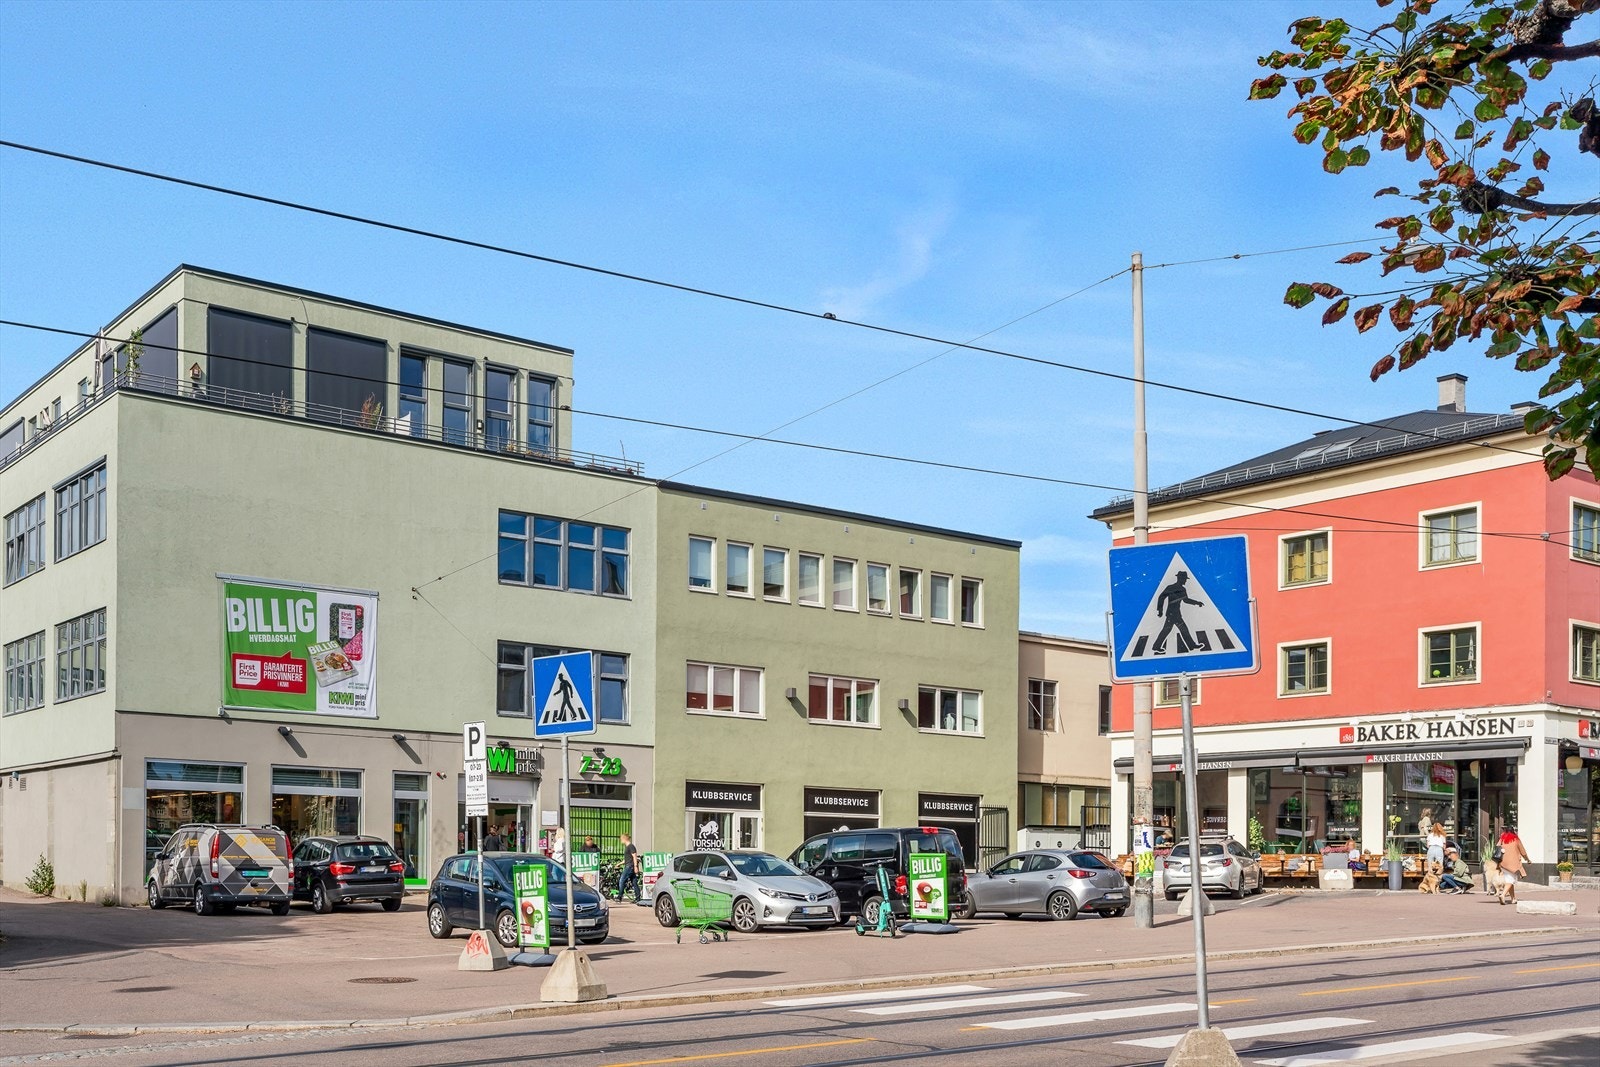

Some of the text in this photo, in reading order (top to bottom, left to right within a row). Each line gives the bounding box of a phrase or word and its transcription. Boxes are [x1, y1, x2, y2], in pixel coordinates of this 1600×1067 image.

[226, 597, 315, 633] BILLIG
[249, 634, 297, 643] HVERDAGSMAT
[307, 640, 339, 655] BILLIG
[239, 663, 256, 671] First
[263, 662, 303, 674] GARANTERTE
[239, 669, 258, 678] Price
[263, 671, 303, 682] PRISVINNERE
[329, 691, 355, 706] KIWI
[1356, 723, 1421, 743] BAKER
[1427, 717, 1516, 740] HANSEN
[469, 726, 480, 757] P
[487, 746, 538, 773] WI mini
[1373, 752, 1444, 763] BAKER HANSEN
[517, 760, 537, 774] pris
[1201, 761, 1233, 770] HANSEN
[692, 790, 753, 802] KLUBBSERVICE
[814, 796, 869, 807] KLUBBSERVICE
[923, 801, 974, 812] KLUBBSERVICE
[692, 838, 726, 848] TORSHOV
[911, 857, 942, 875] BILLIG
[516, 869, 543, 891] BILLIG
